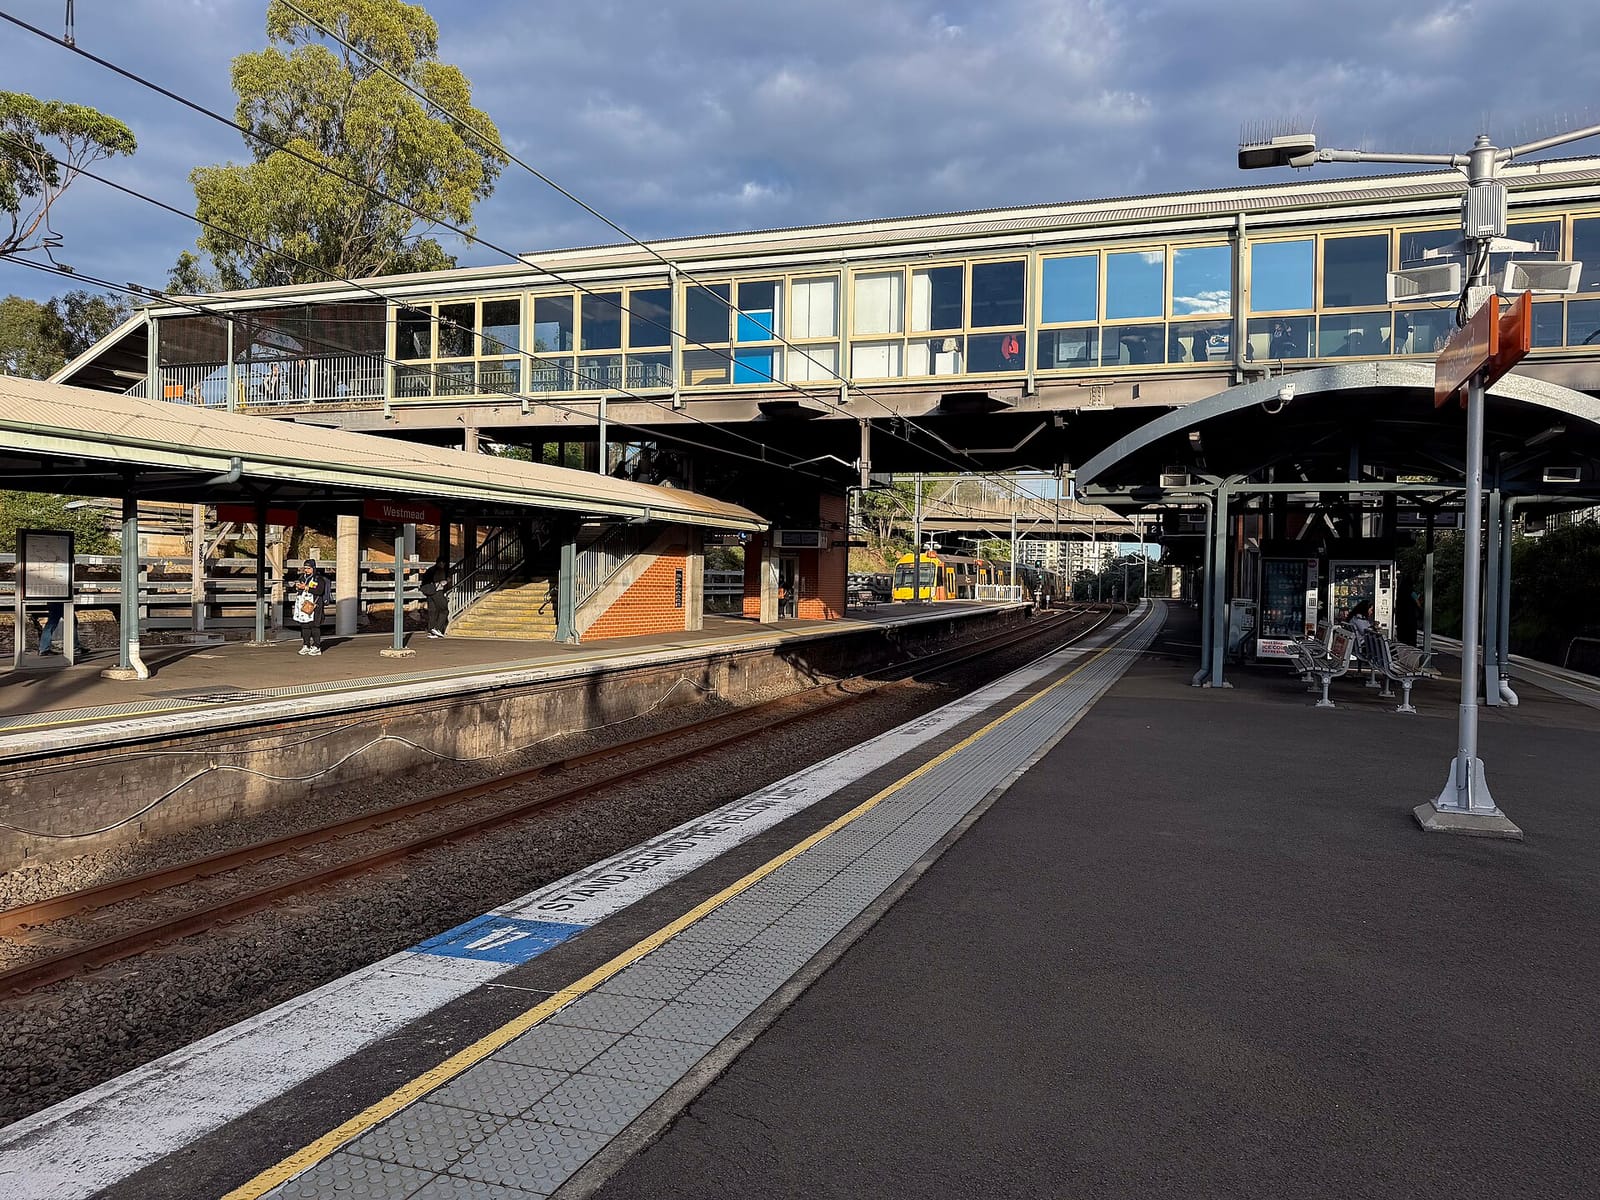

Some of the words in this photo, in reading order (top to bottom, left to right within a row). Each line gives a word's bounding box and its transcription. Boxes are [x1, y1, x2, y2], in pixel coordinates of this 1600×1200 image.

[383, 506, 425, 520] Westmead
[537, 874, 631, 911] STAND
[615, 841, 698, 873] BEHIND
[682, 826, 731, 840] THE
[710, 800, 782, 825] YELLOW
